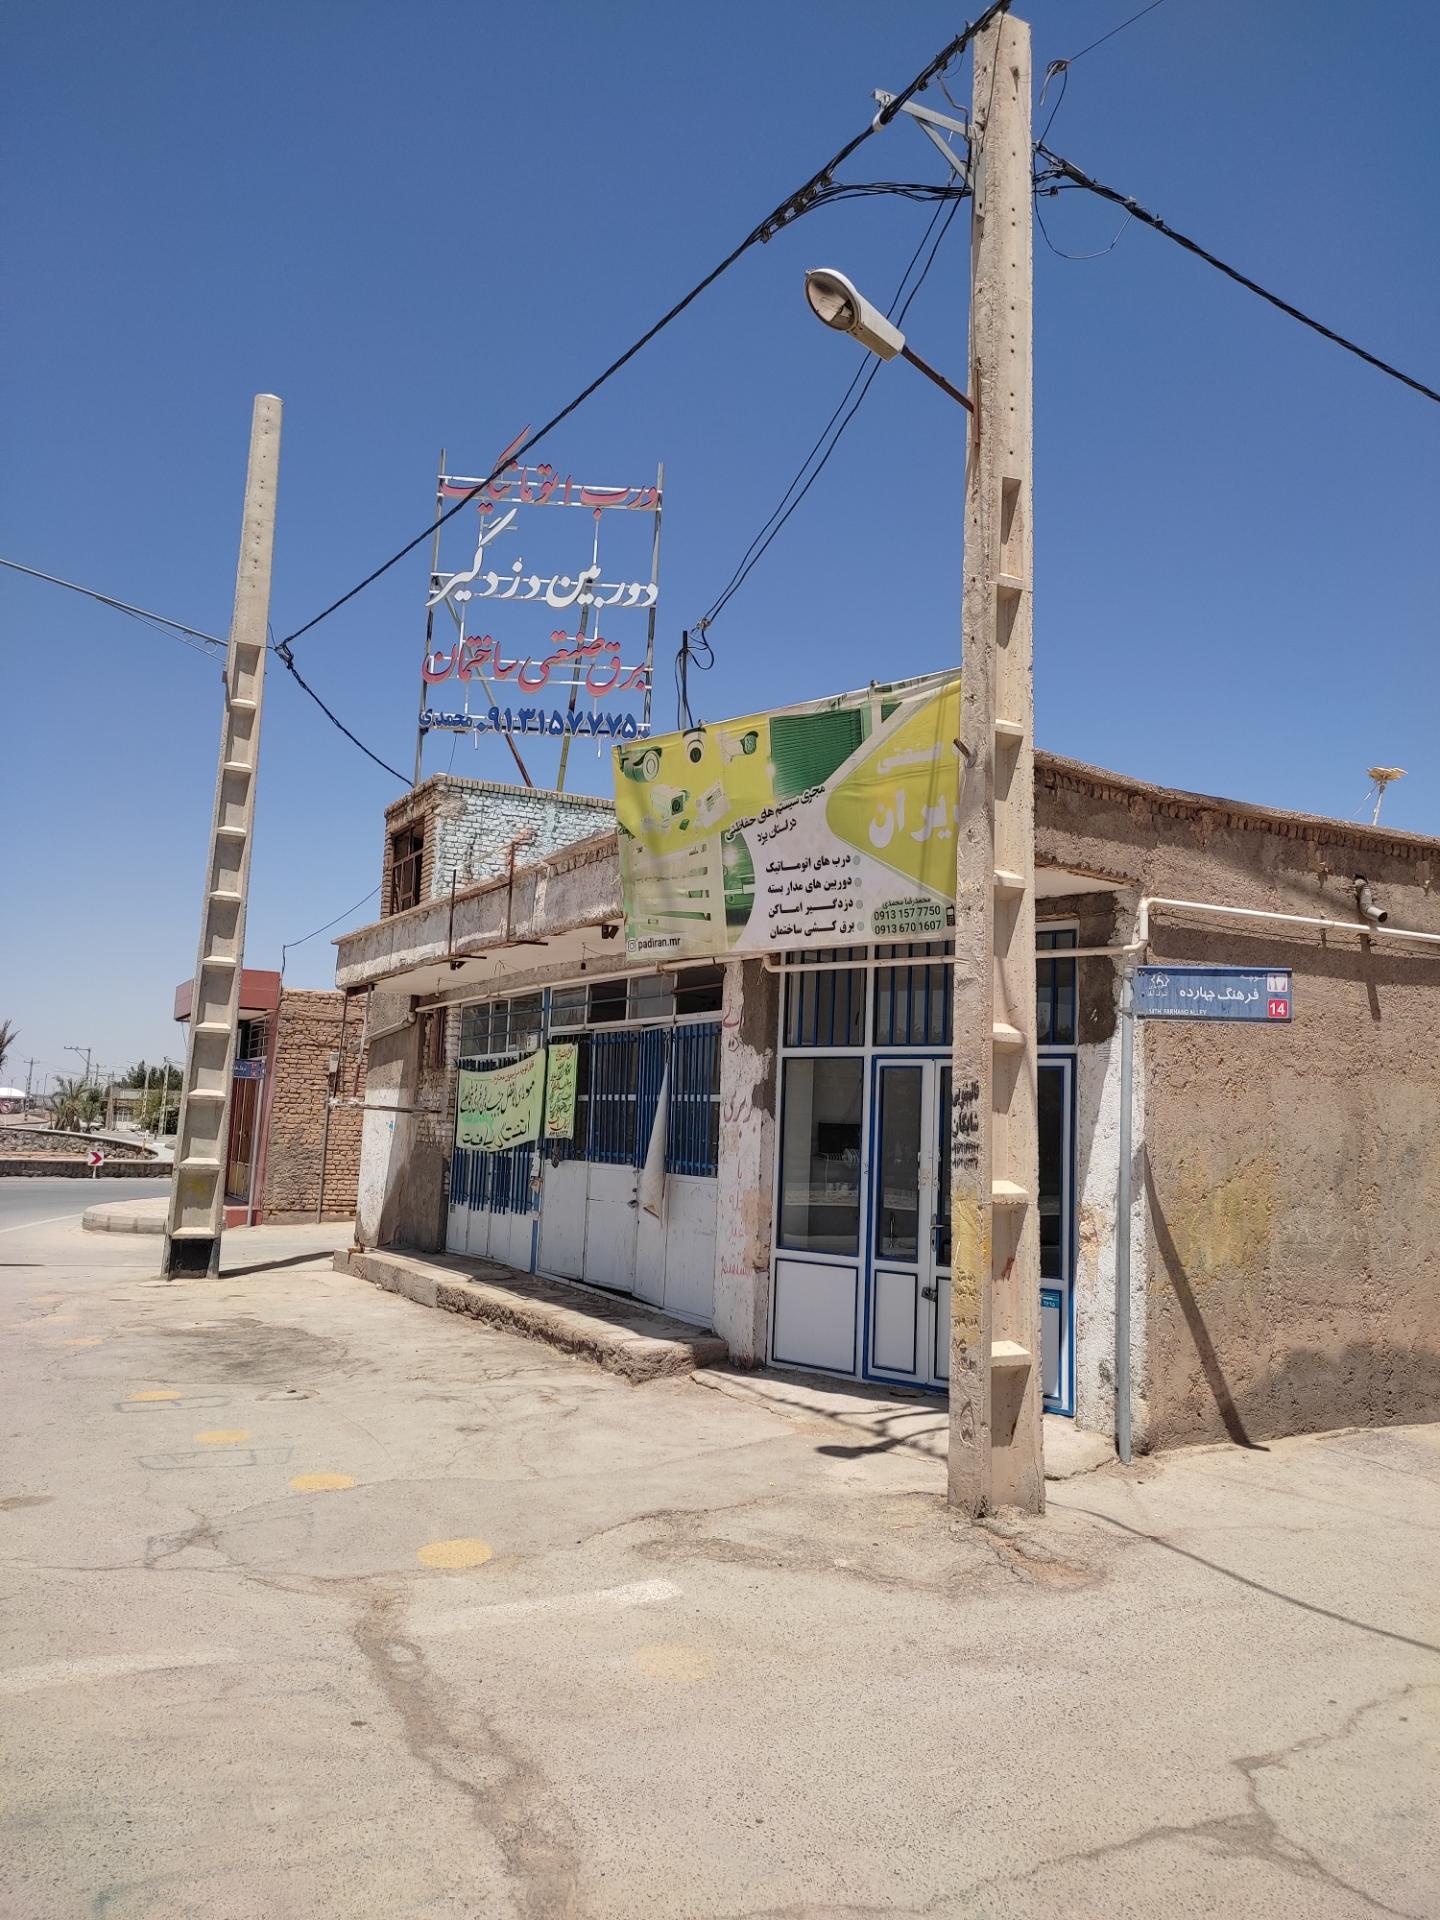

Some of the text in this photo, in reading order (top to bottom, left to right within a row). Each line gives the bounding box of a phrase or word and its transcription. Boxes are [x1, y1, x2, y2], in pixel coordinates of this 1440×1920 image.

[441, 424, 658, 519] درب اتوماتیک
[425, 508, 658, 608] دوربین دزدگیر
[421, 631, 647, 697] برق صنعتی ساختمان
[418, 709, 473, 727] محمدی
[726, 785, 826, 841] مجری سیستم های حفاظتی
[757, 818, 797, 846] در استان یزد
[765, 854, 851, 875] درب های اتوماتیک
[767, 877, 852, 896] دوربین های مدار بسته
[768, 898, 853, 918] دزدگیر اماکن
[873, 905, 941, 921] 0913 157 7750
[882, 897, 931, 910] محمدرضا محمدی
[769, 920, 855, 939] برق کشی ساختمان
[874, 920, 941, 935] 0913 670 1607
[638, 938, 681, 951] padiran.mr
[1179, 986, 1216, 1001] چهارده
[1217, 985, 1260, 1004] فرهنگ
[1269, 1002, 1286, 1015] 14
